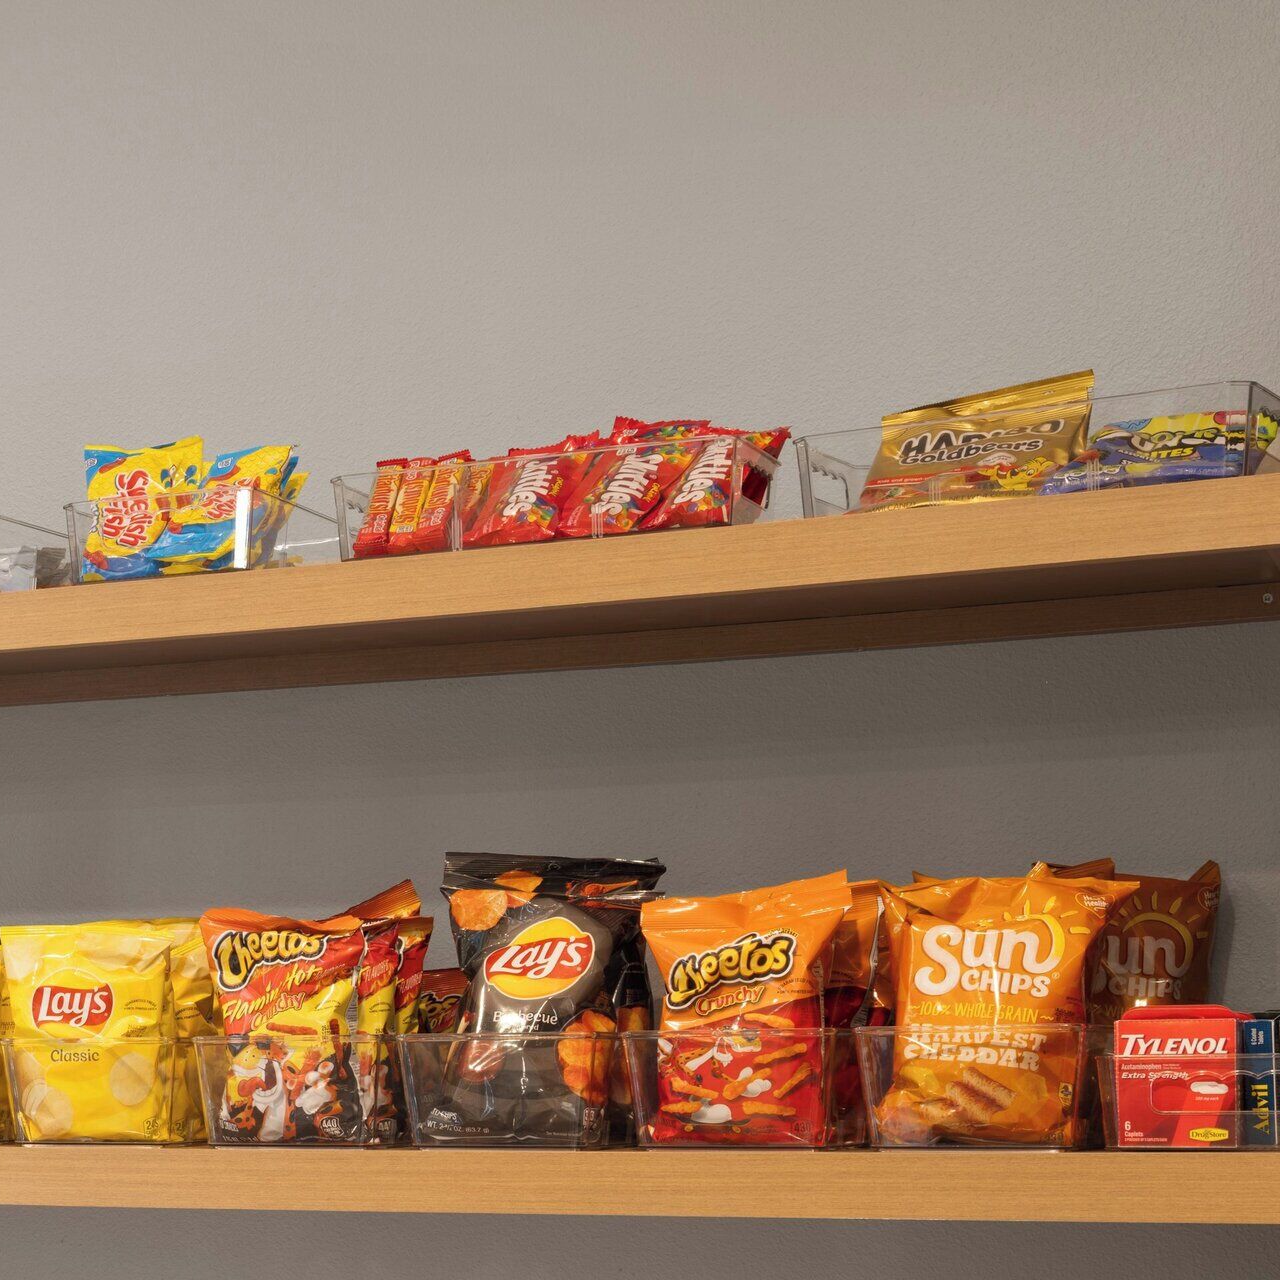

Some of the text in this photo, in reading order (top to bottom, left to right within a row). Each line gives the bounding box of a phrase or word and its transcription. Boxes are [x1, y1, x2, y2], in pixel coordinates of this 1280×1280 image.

[899, 439, 1043, 466] Goldbears
[597, 453, 664, 516] Skittles
[116, 470, 153, 547] Swedish
[217, 930, 327, 990] Cheetos
[489, 935, 590, 980] Lay's
[668, 930, 793, 1008] Cheetos
[914, 918, 1053, 997] Sun
[696, 984, 763, 1015] Crunchy
[960, 967, 1051, 998] CHIPS
[37, 985, 111, 1028] Lay's
[920, 1003, 1040, 1023] 100% WHOLE GRAIN
[50, 1048, 99, 1063] Classic
[904, 1043, 1041, 1071] CHEDDAR
[1121, 1034, 1228, 1058] TYLENOL
[1125, 1121, 1131, 1131] 6
[1253, 1083, 1271, 1136] Advil
